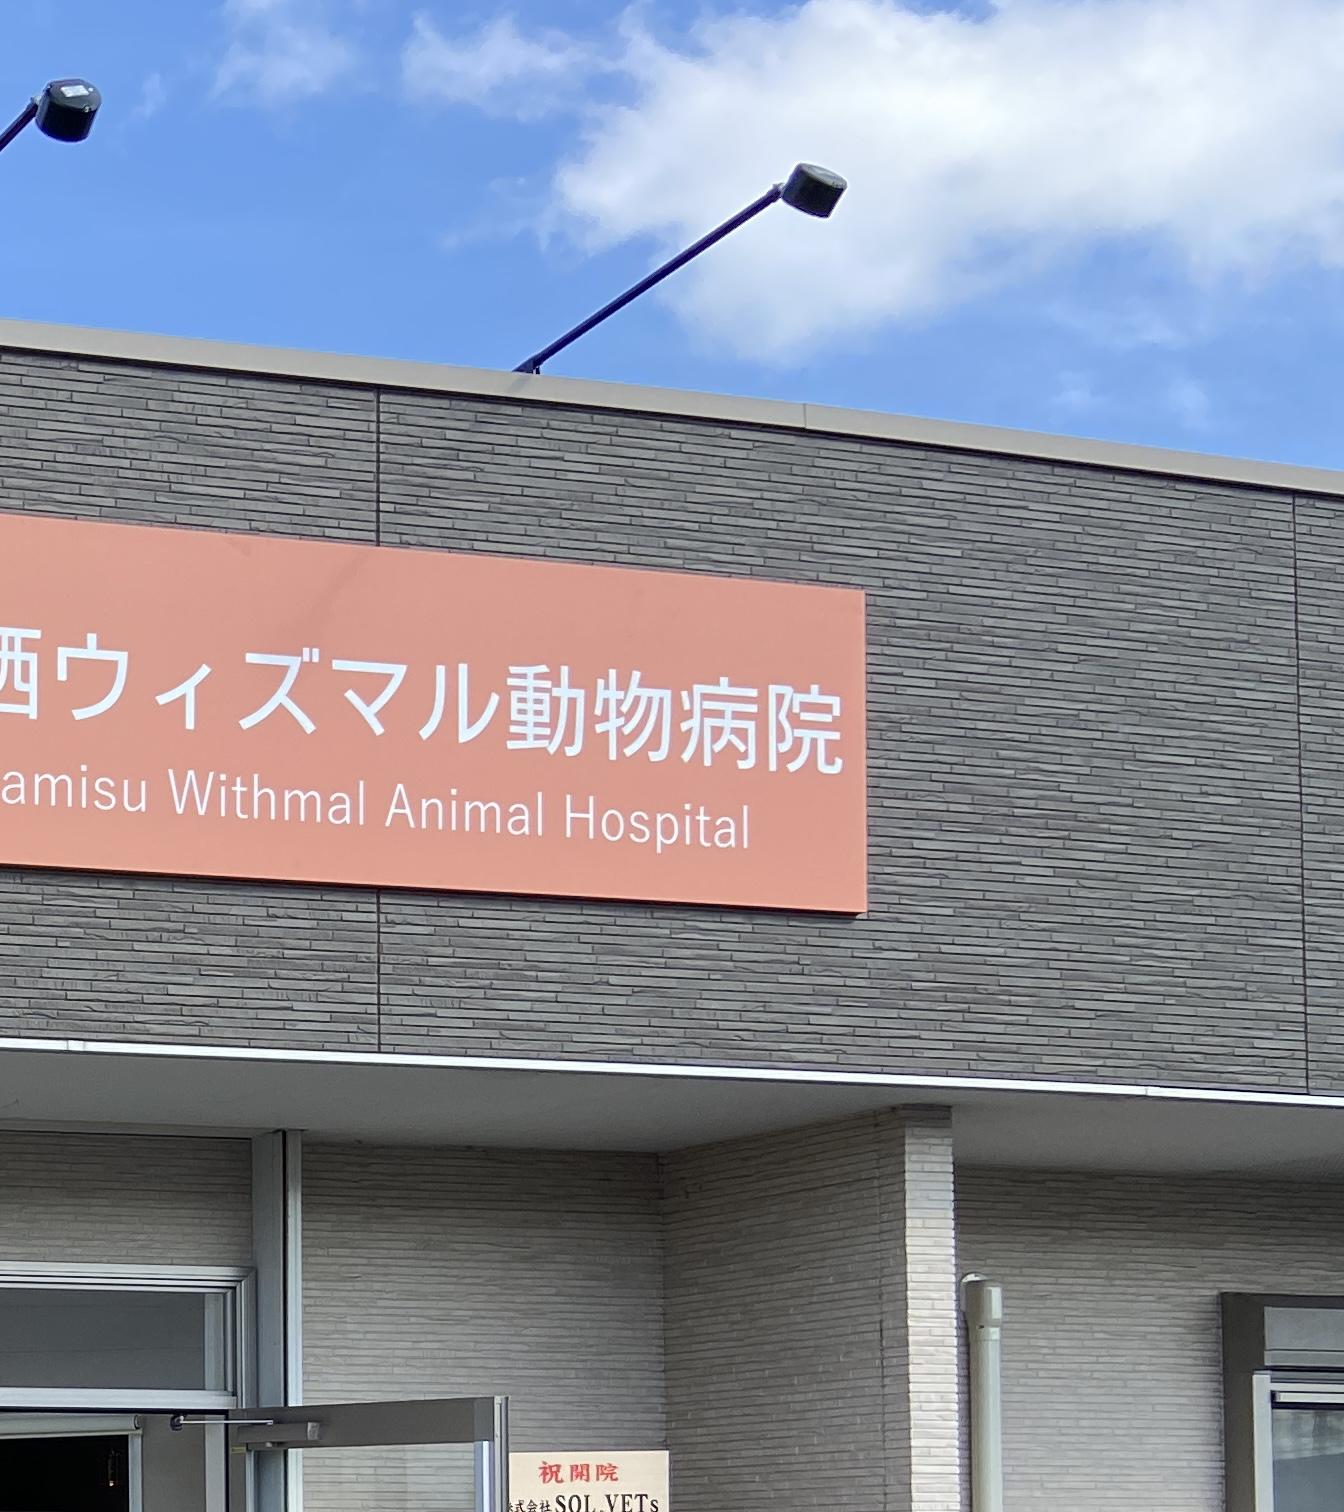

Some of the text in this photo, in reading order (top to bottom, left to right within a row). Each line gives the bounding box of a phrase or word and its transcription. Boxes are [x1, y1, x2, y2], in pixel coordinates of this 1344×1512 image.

[167, 769, 365, 826] Withmal
[384, 783, 544, 837] Animal
[565, 795, 749, 854] Hospital
[538, 1461, 620, 1484] 祝開院
